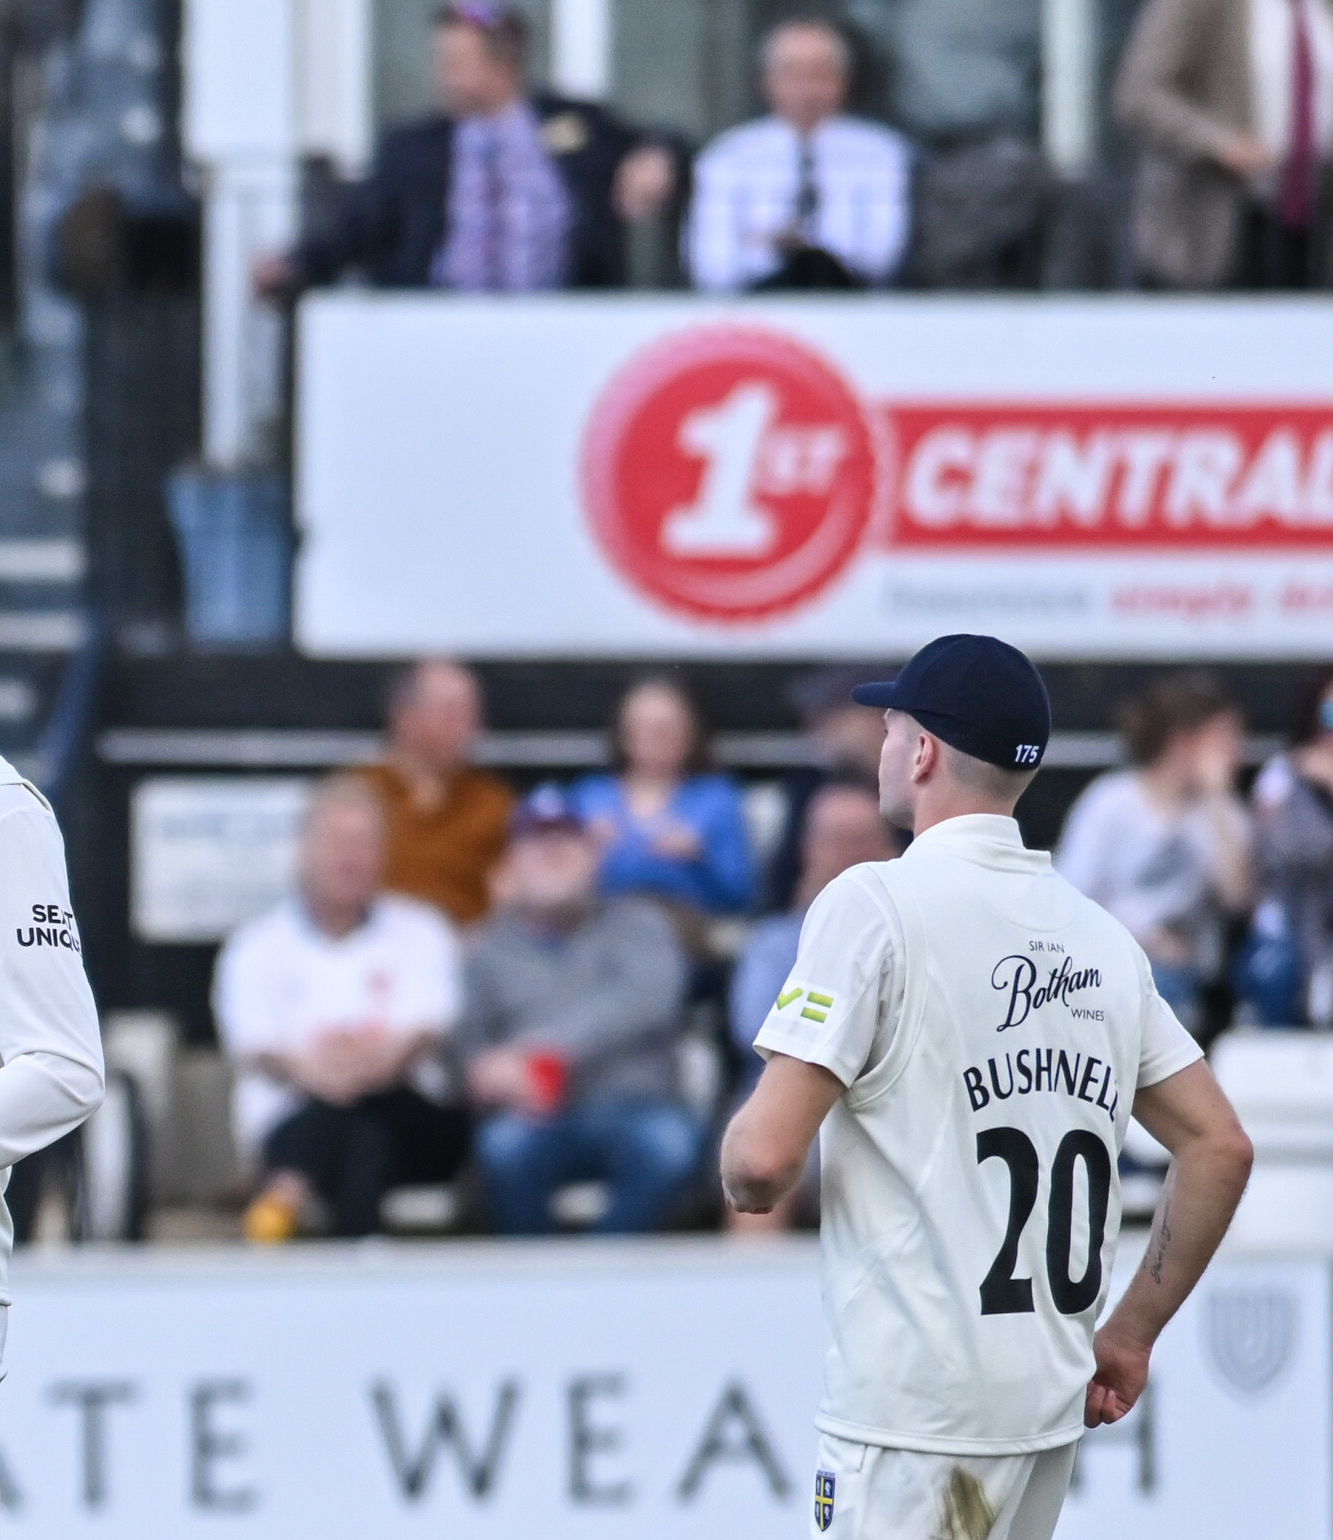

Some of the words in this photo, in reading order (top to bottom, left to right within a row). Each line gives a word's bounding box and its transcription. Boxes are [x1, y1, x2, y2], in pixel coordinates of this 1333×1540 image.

[1014, 744, 1039, 763] 175
[1028, 940, 1045, 952] SIR
[1047, 942, 1065, 953] IAN
[991, 954, 1102, 1032] Botham
[1071, 1008, 1105, 1021] WINES
[977, 1126, 1112, 1316] 20
